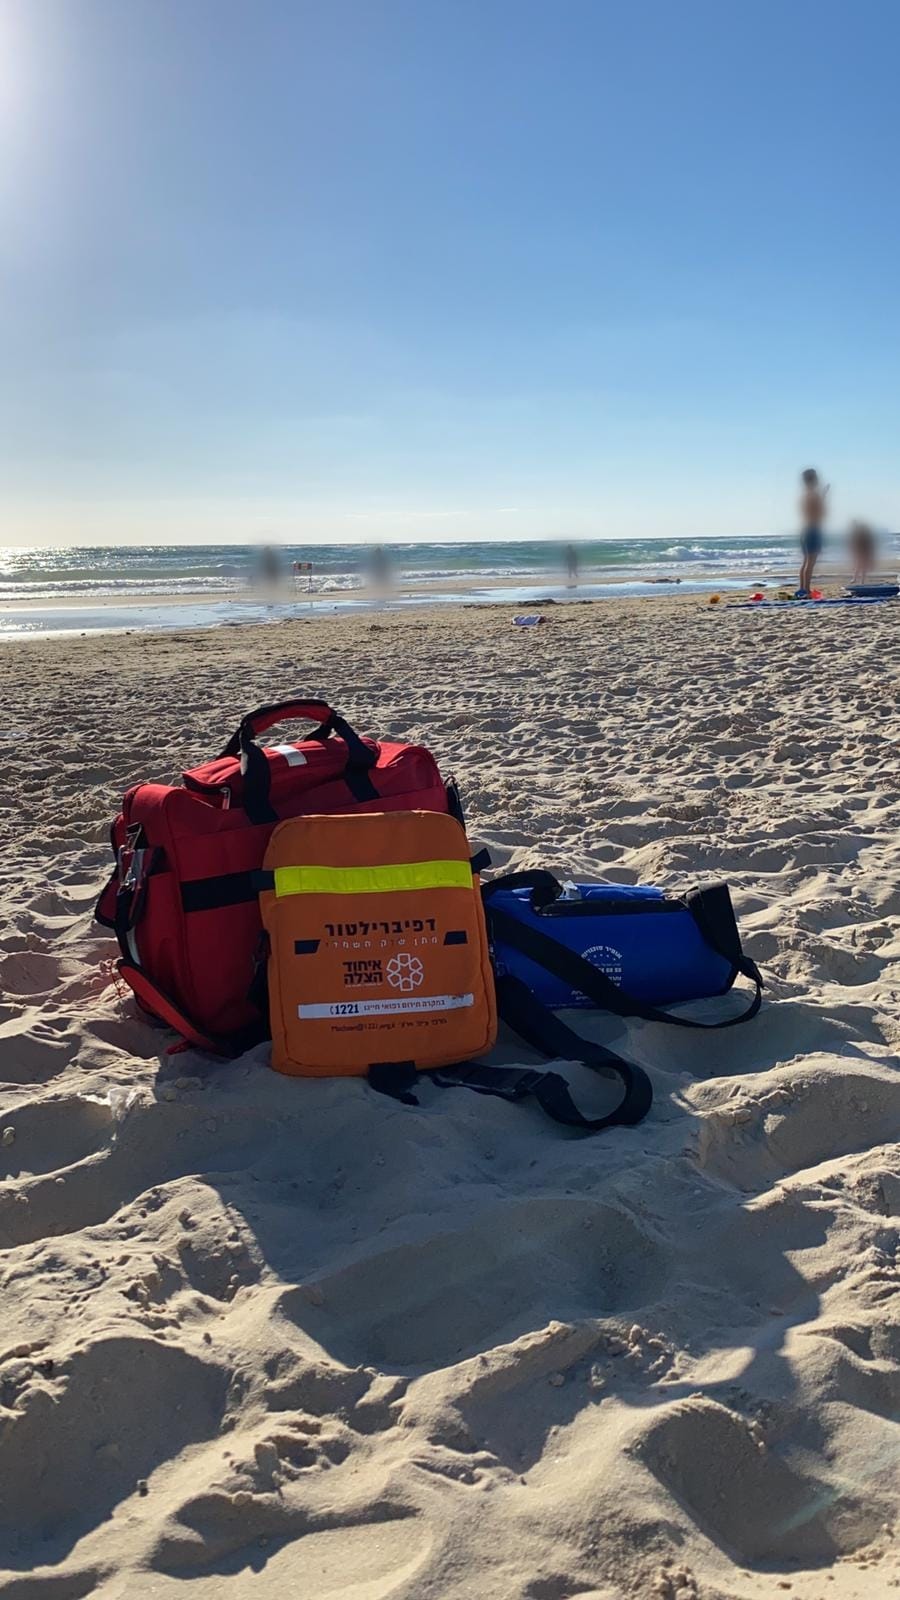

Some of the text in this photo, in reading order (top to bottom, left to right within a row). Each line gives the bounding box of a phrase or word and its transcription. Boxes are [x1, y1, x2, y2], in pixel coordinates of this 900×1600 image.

[325, 918, 436, 937] דפיברילטור
[413, 936, 438, 946] מתן
[342, 959, 382, 972] איחוד
[343, 971, 383, 985] הצלה
[335, 1003, 359, 1015] 1221
[402, 1001, 421, 1009] חירום
[422, 999, 446, 1009] במקרה
